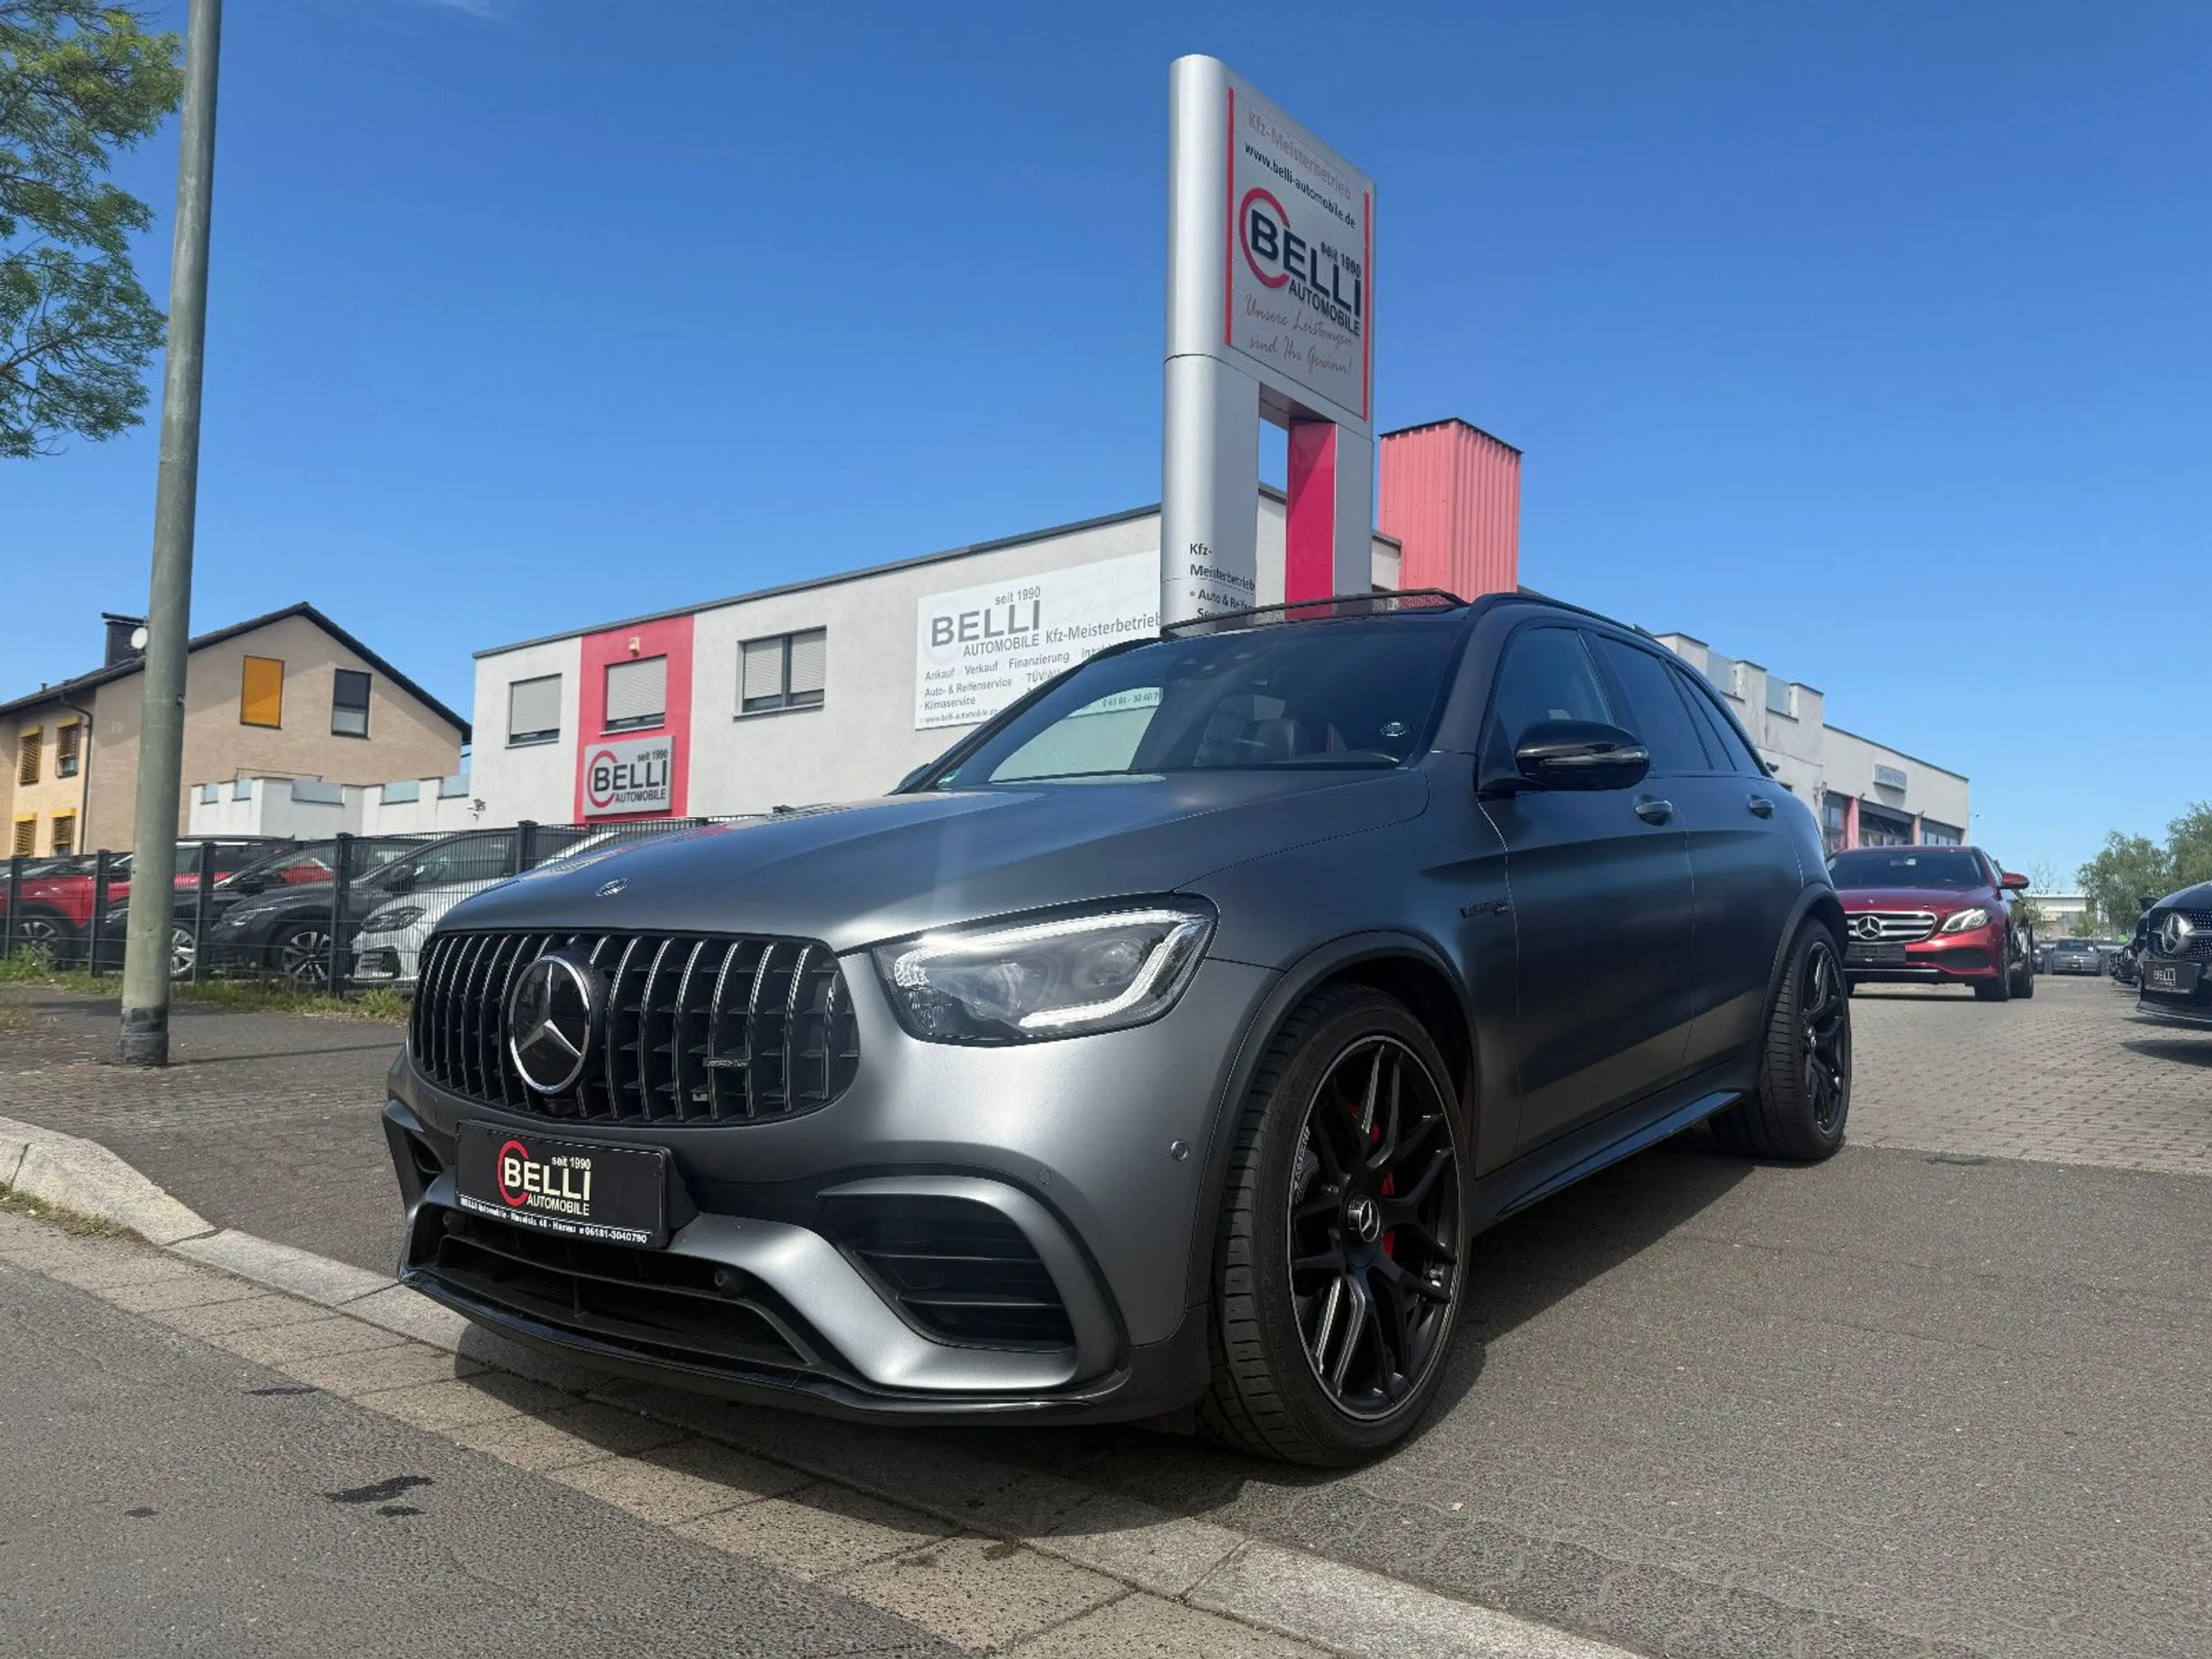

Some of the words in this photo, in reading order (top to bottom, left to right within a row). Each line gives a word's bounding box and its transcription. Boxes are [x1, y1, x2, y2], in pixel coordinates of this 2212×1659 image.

[1248, 111, 1351, 200] Kfz-Meisterbetrieb
[1245, 142, 1356, 229] www.belli-automobile.de
[1251, 209, 1361, 317] BELLI
[1321, 241, 1338, 262] seit
[1340, 253, 1361, 277] 1990
[1288, 279, 1360, 336] AUTOMOBILE
[1245, 294, 1287, 326] Unsere
[1293, 310, 1353, 354] Leistungen
[1249, 334, 1278, 353] sind
[1307, 344, 1353, 376] Gewinn!
[1190, 543, 1212, 555] Kfz-
[1190, 564, 1255, 591] Meisterbetrieb
[995, 592, 1013, 605] seit
[1017, 586, 1040, 601] 1990
[1198, 589, 1220, 604] Auto
[931, 599, 1040, 647] BELLI
[963, 634, 1039, 657] AUTOMOBILE
[925, 667, 955, 681] Ankauf
[964, 661, 998, 676] Verkauf
[1009, 652, 1070, 669] Finanzierung
[925, 687, 946, 698] Auto-
[948, 684, 954, 695] &
[956, 677, 1012, 694] Reifenservice
[925, 696, 976, 710] Klimaservice
[637, 751, 650, 762] seit
[652, 748, 668, 761] 1990
[594, 760, 667, 792] BELLI
[615, 789, 666, 802] AUTOMOBILE
[551, 1156, 568, 1167] seit
[569, 1157, 592, 1171] 1990
[504, 1157, 592, 1201] BELLI
[527, 1193, 590, 1217] AUTOMOBILE
